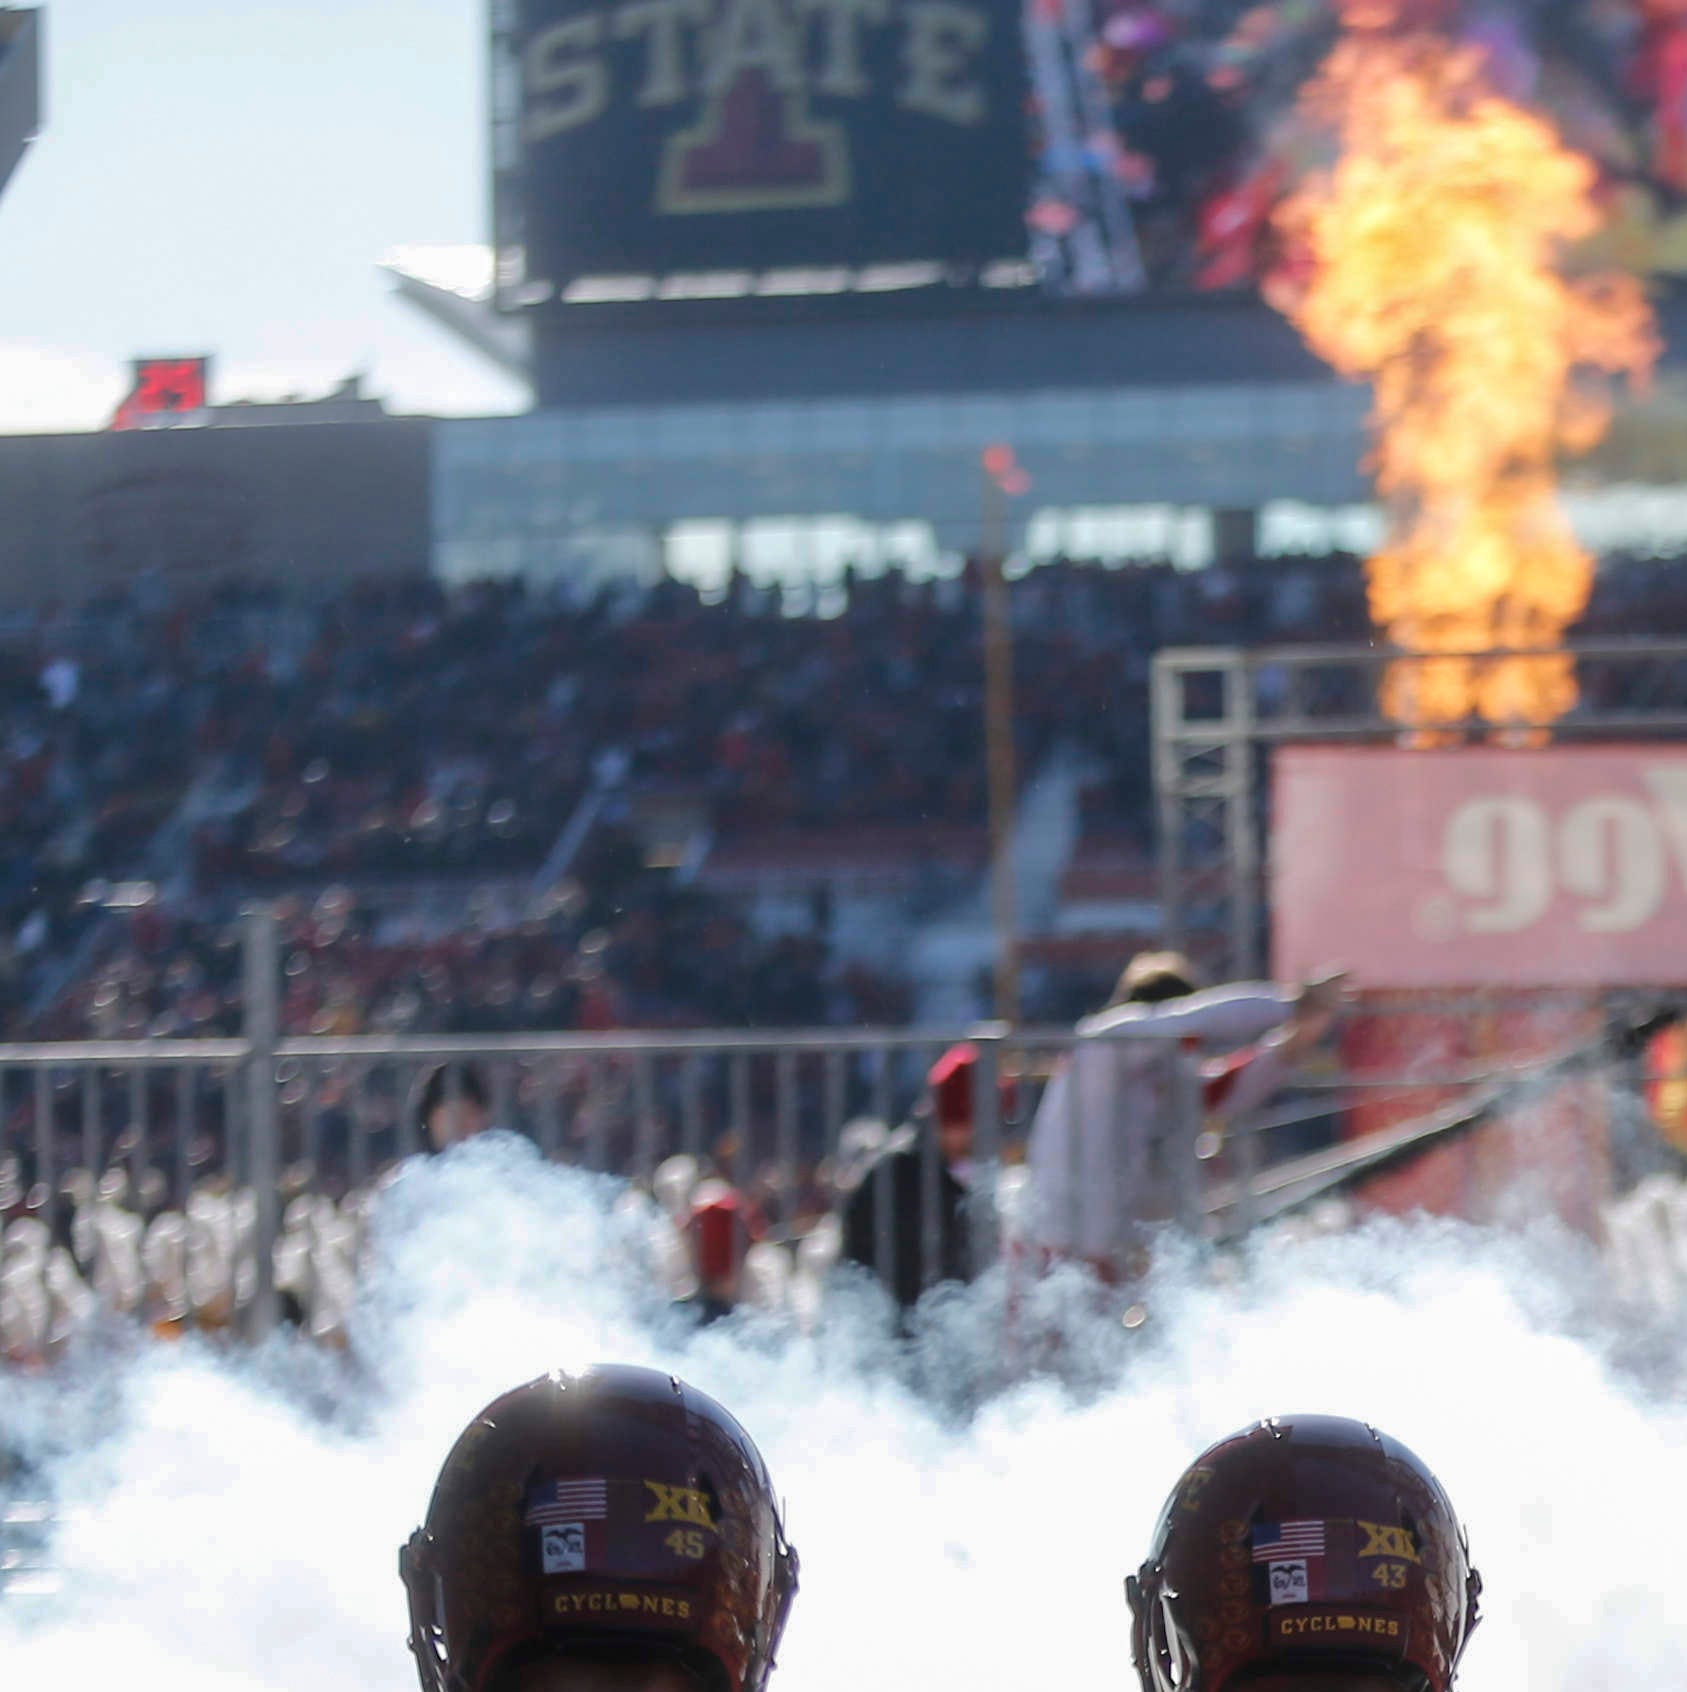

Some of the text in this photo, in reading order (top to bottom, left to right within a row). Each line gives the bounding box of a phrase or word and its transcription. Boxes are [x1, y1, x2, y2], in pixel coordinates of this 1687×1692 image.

[524, 0, 989, 142] STATE
[664, 1530, 705, 1559] 45
[1372, 1564, 1407, 1588] 43
[555, 1593, 691, 1619] CYCLONES
[1280, 1615, 1399, 1636] CYCLONES
